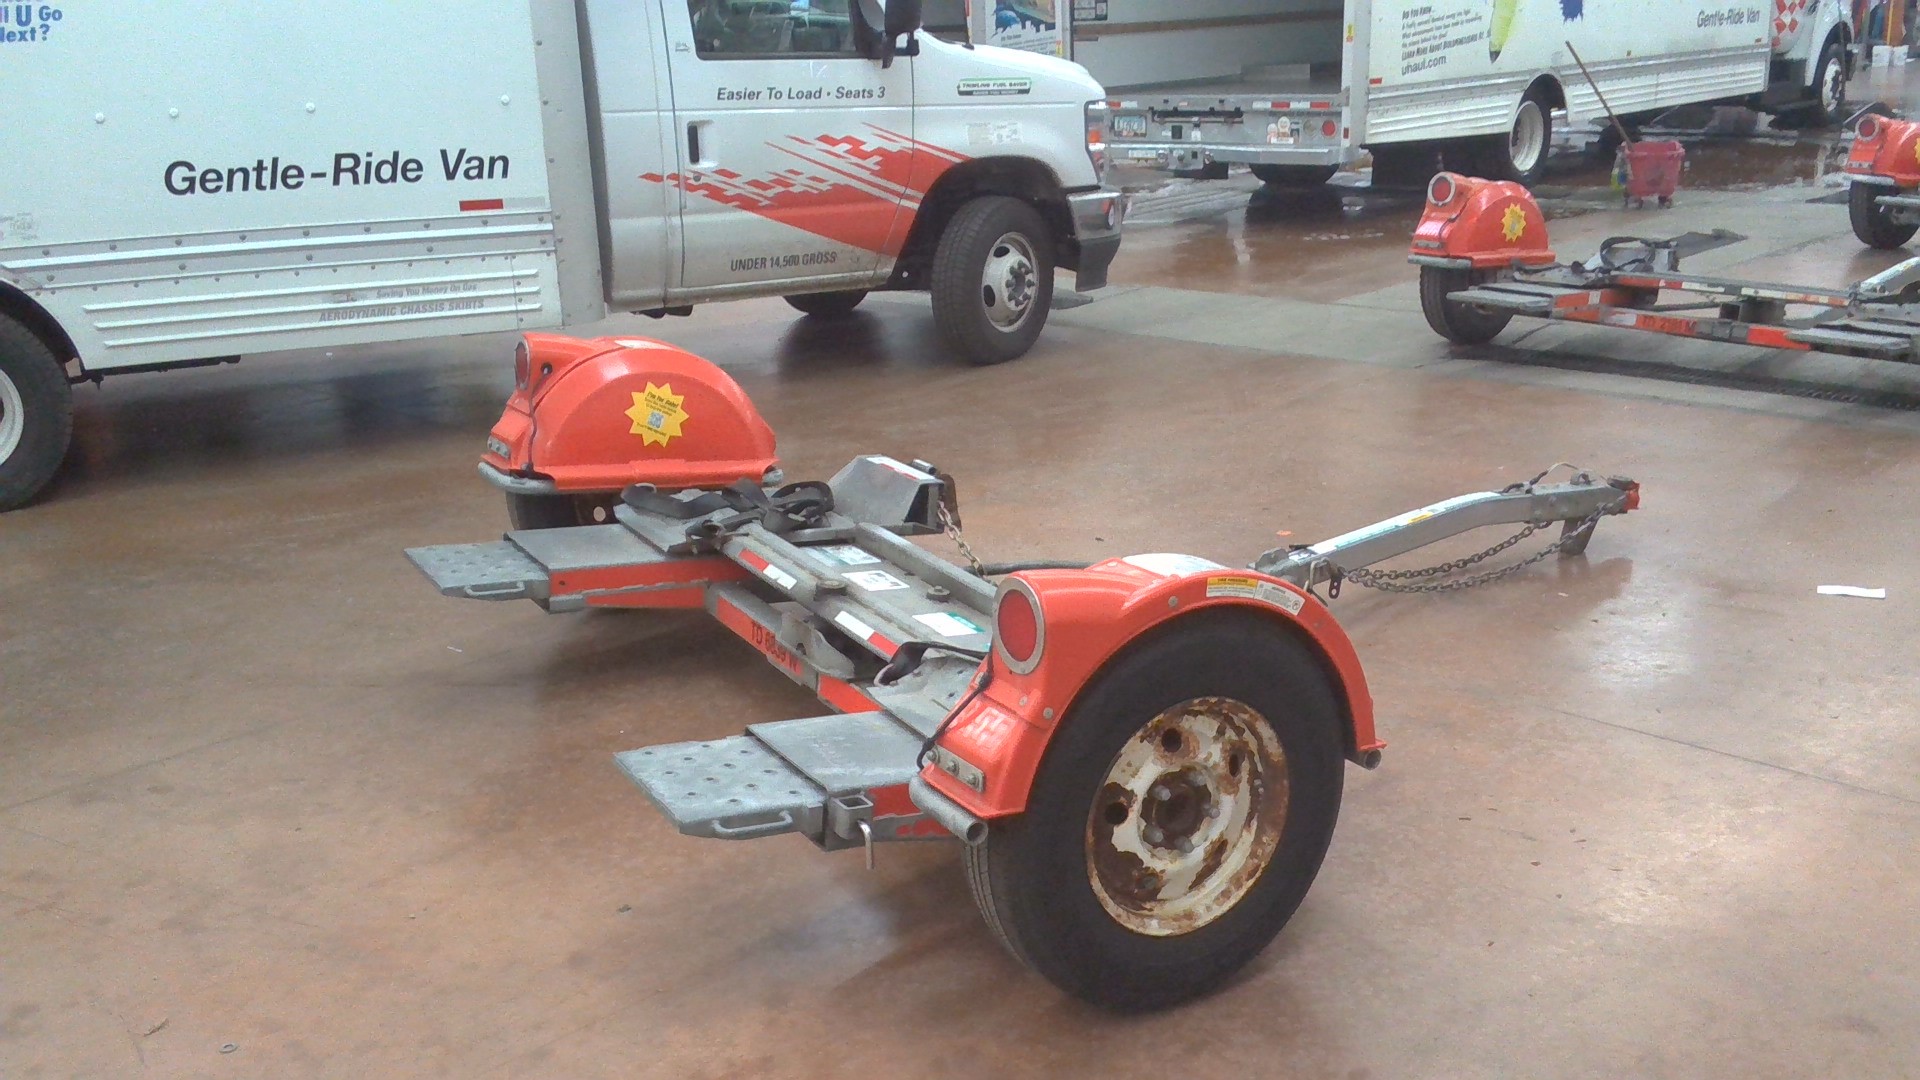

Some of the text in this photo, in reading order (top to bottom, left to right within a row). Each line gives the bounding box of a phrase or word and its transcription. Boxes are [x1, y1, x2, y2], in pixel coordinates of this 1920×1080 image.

[16, 5, 32, 27] U
[39, 5, 63, 21] Go
[1697, 7, 1760, 28] Gentle-Ride Van
[1401, 55, 1447, 76] uhaul.com
[717, 86, 886, 101] Easier To Load Seats 3
[164, 148, 511, 196] Gentle-Ride Van
[730, 251, 838, 271] UNDER 14,500 GROSS
[376, 288, 404, 299] Saving
[406, 286, 421, 296] You
[422, 284, 448, 296] Money
[450, 283, 461, 292] On
[319, 305, 397, 322] AERODYNAMIC
[400, 303, 445, 316] CHASSIS
